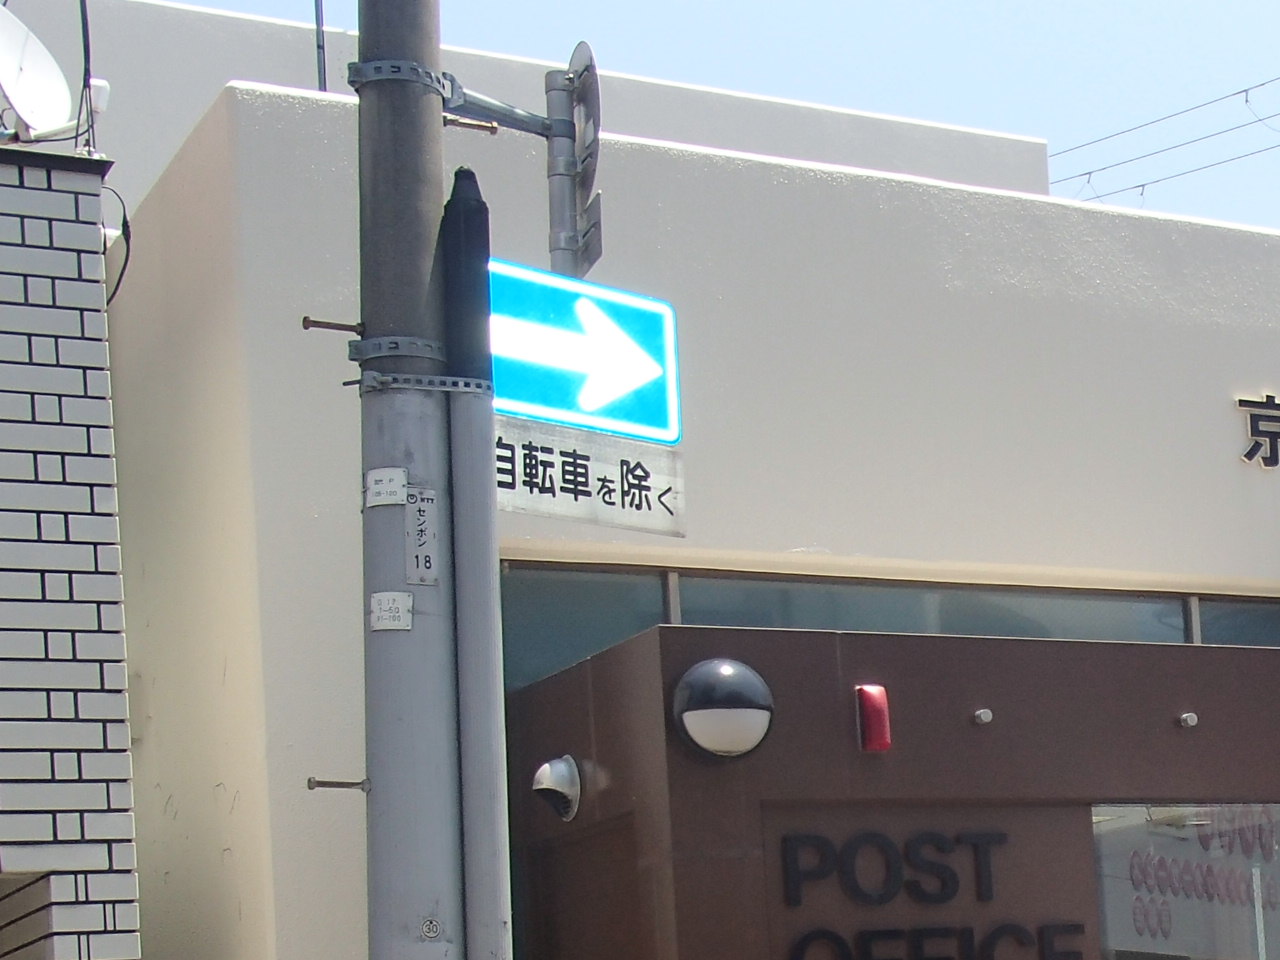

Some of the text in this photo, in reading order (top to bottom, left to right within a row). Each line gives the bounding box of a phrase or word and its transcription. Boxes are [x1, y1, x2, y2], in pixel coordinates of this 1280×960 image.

[496, 436, 674, 516] 自転車を除く
[416, 507, 427, 548] センボン
[414, 554, 432, 570] 18
[781, 828, 1008, 907] POST
